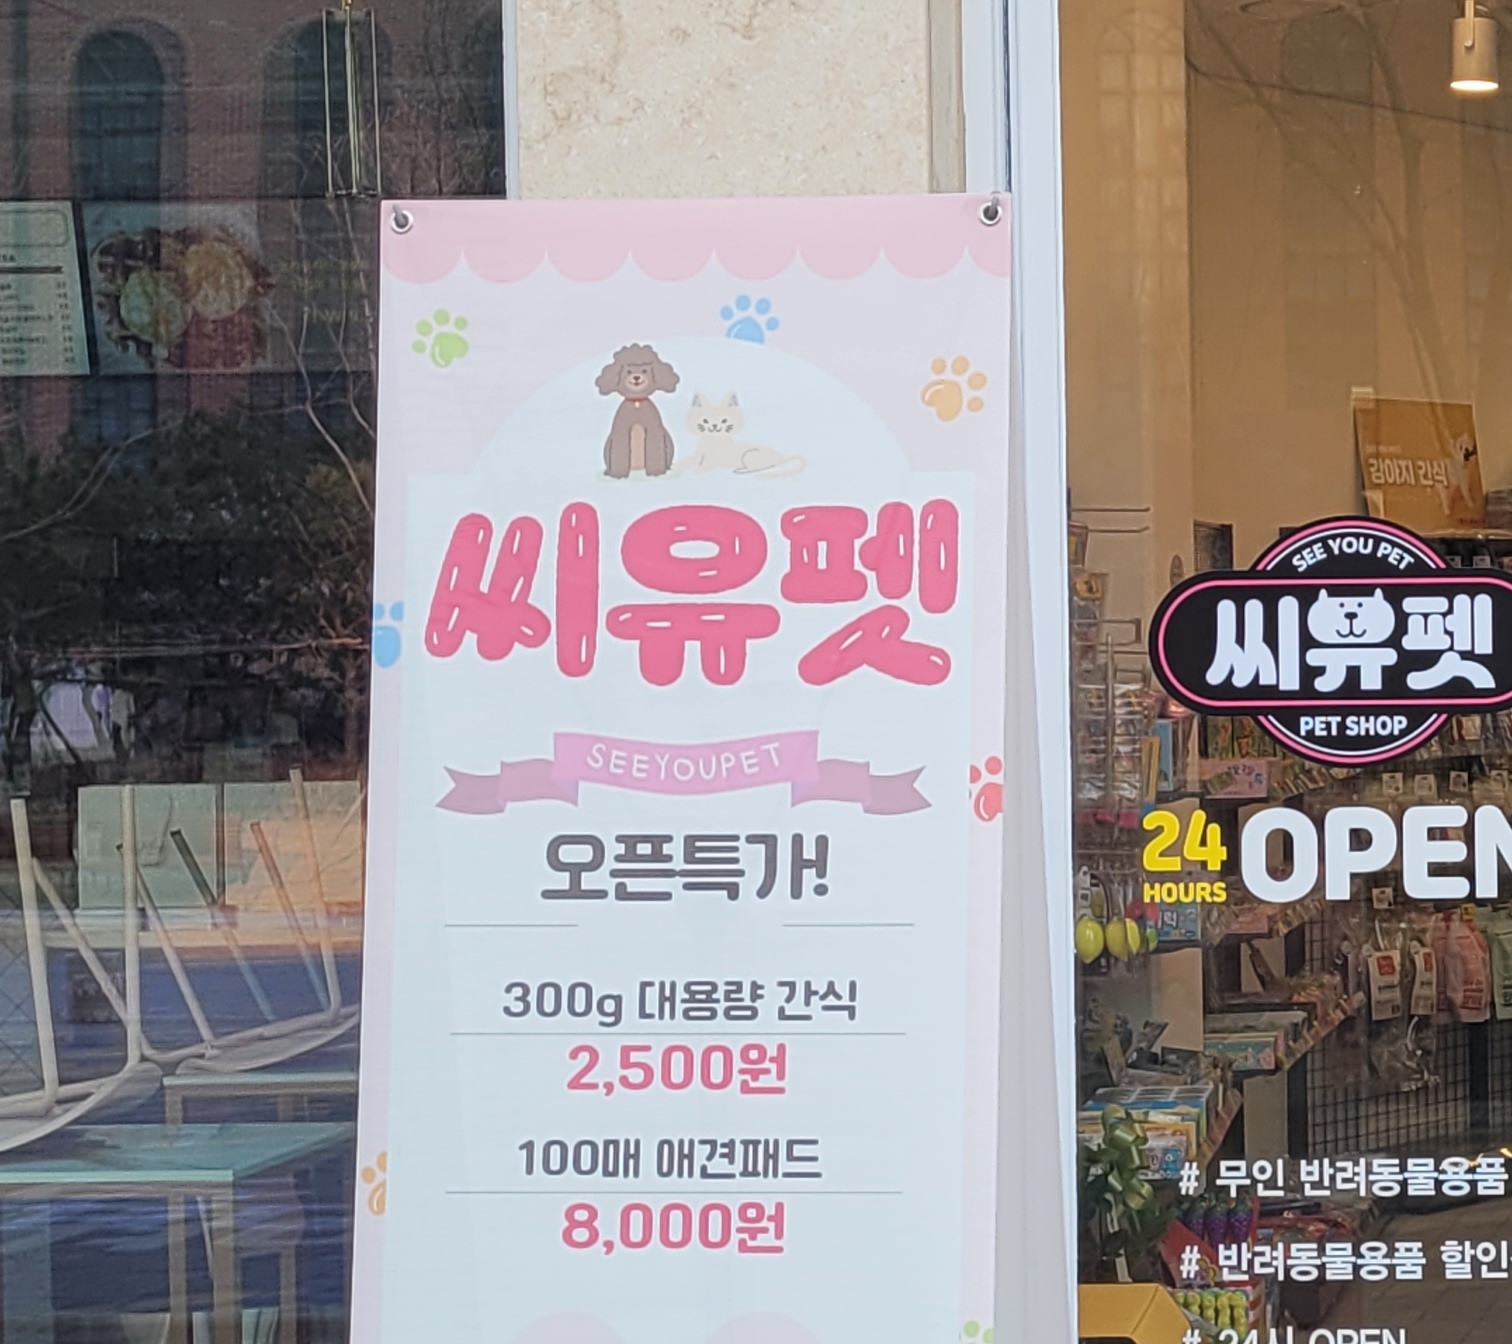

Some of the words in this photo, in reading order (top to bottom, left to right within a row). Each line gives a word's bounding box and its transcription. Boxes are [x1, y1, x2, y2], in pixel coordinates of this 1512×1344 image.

[1292, 541, 1328, 571] SEE
[1328, 537, 1373, 554] YOU
[1377, 540, 1414, 569] PET
[424, 498, 959, 686] 씨유펫
[1206, 588, 1495, 692] 씨유펫
[1300, 716, 1341, 736] PET
[1346, 715, 1408, 737] SHOP
[586, 744, 780, 782] SEEYOUPET
[1142, 810, 1226, 872] 24
[541, 833, 828, 901] 오픈특가!
[1143, 881, 1226, 904] HOURS
[503, 982, 622, 1027] 300g
[639, 981, 764, 1021] 대용량
[777, 980, 856, 1020] 간식
[567, 1043, 786, 1096] 2,500원
[519, 1139, 640, 1178] 100매
[657, 1138, 822, 1179] 애견패드
[1179, 1162, 1199, 1195] #
[1216, 1159, 1284, 1197] 무인
[1301, 1154, 1508, 1196] 반려동물용품
[562, 1202, 784, 1255] 8,000원
[1180, 1246, 1201, 1278] #
[1219, 1242, 1426, 1281] 반려동물용품
